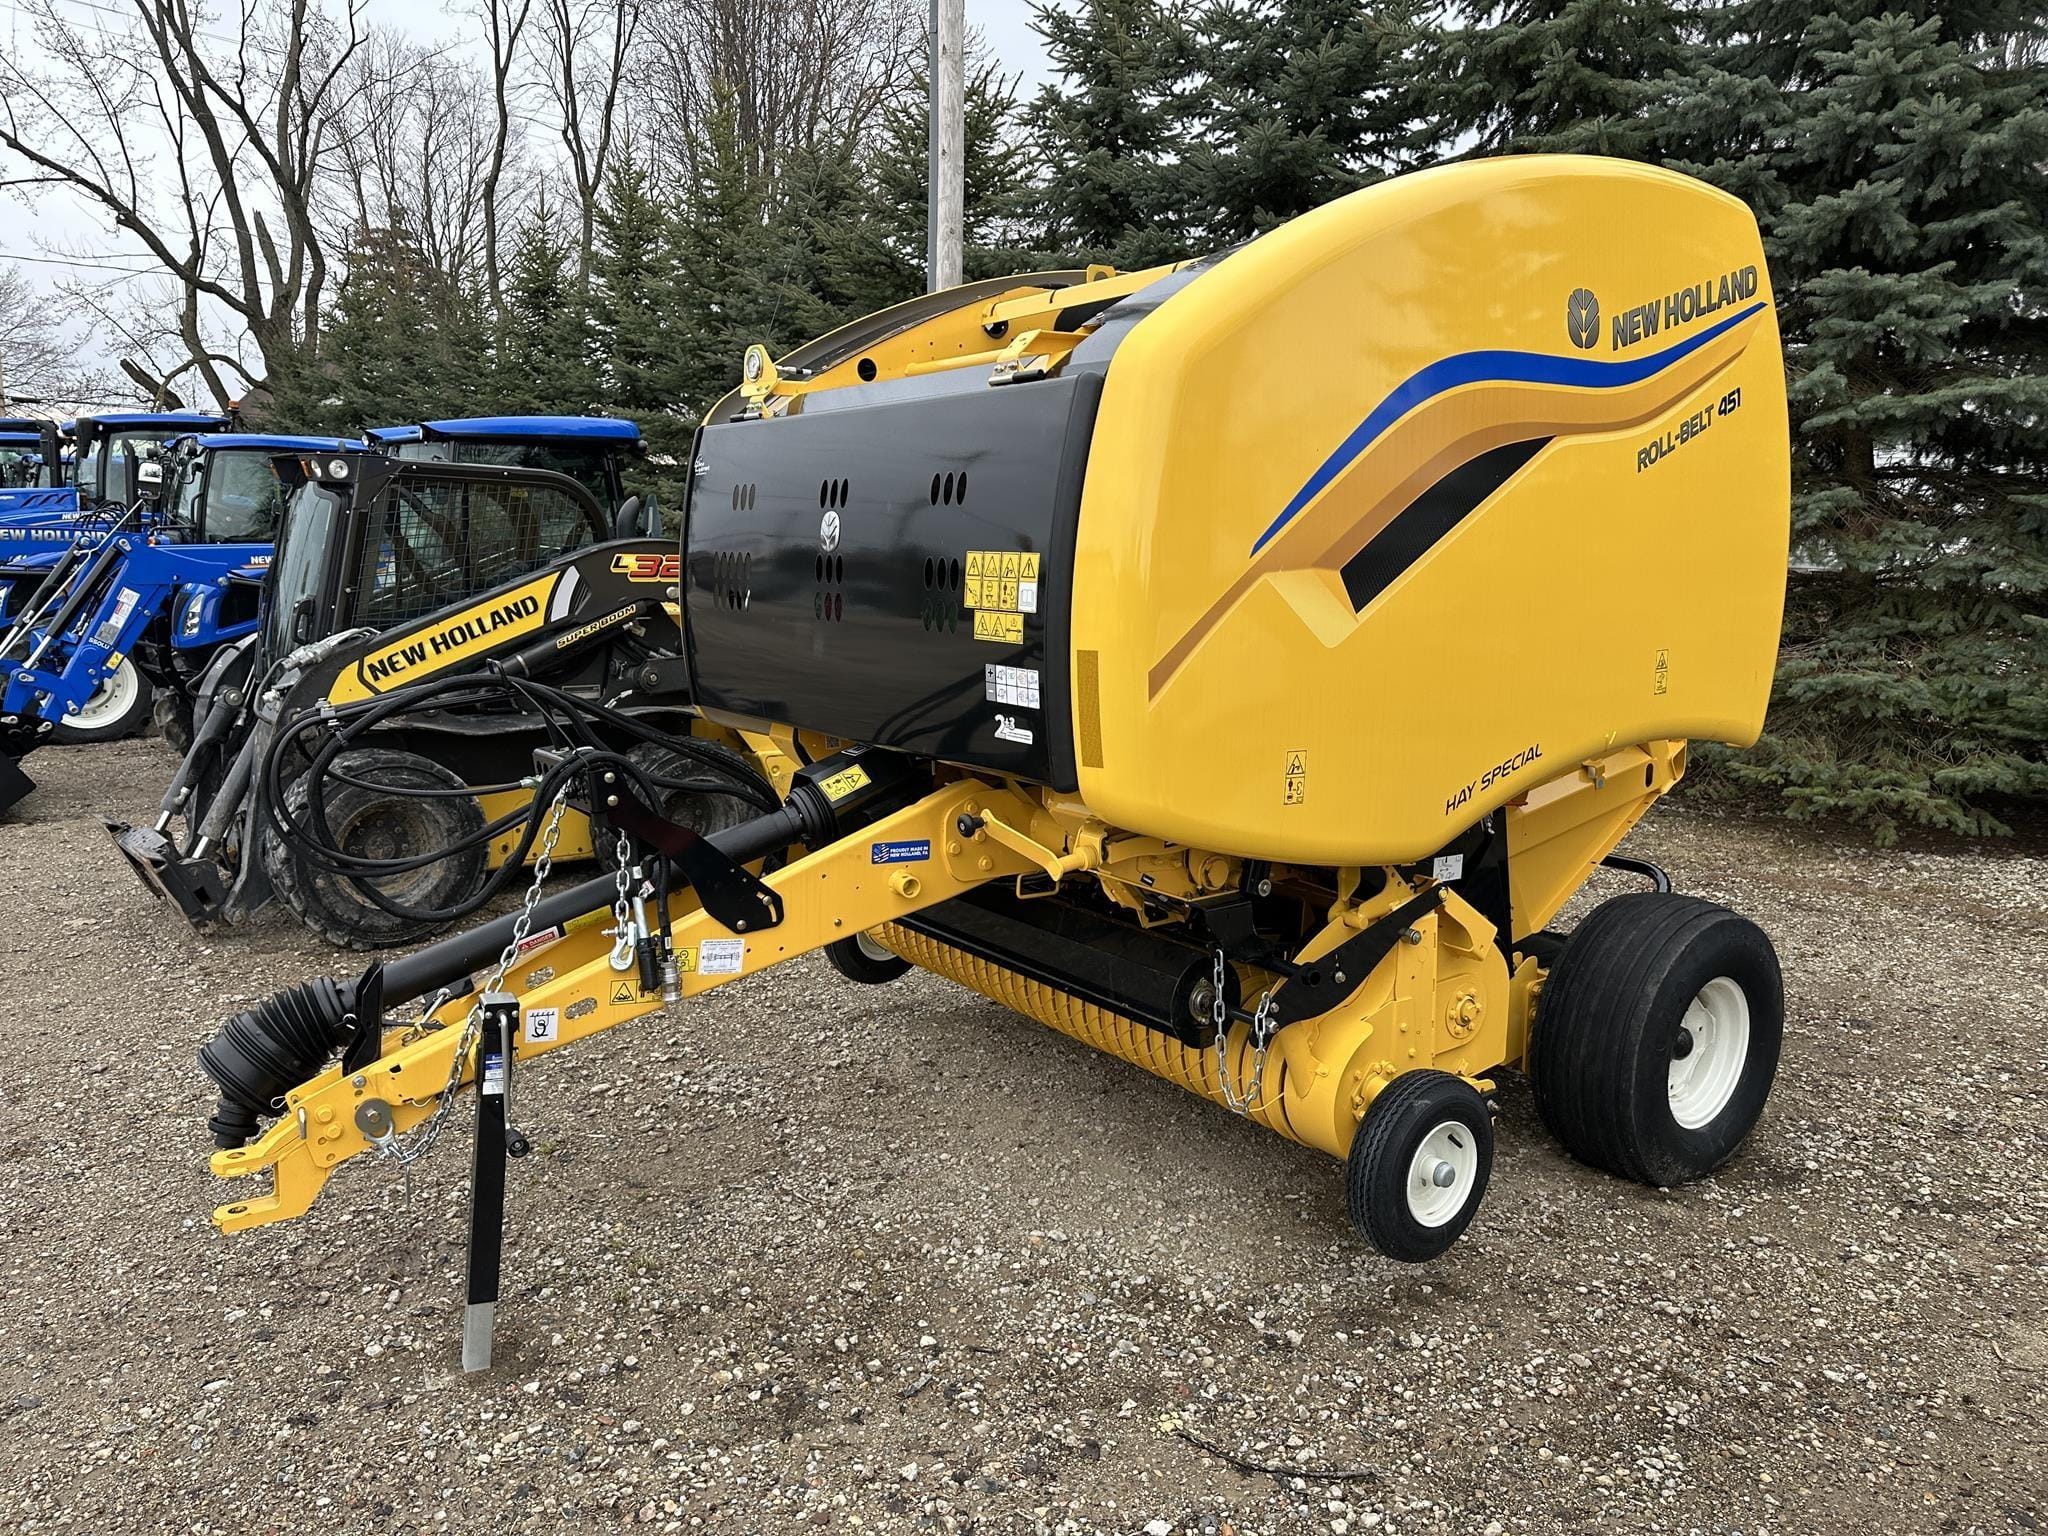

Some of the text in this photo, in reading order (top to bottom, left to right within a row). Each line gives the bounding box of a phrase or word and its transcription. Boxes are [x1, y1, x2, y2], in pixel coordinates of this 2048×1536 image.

[1612, 264, 1758, 351] NEW HOLLAND
[1637, 387, 1741, 473] ROLL-BELT 451
[367, 595, 540, 682] NEW HOLLAND
[557, 604, 637, 648] SUPER BOOM
[1445, 743, 1543, 816] HAY SPECIAL
[529, 932, 554, 946] DANGER
